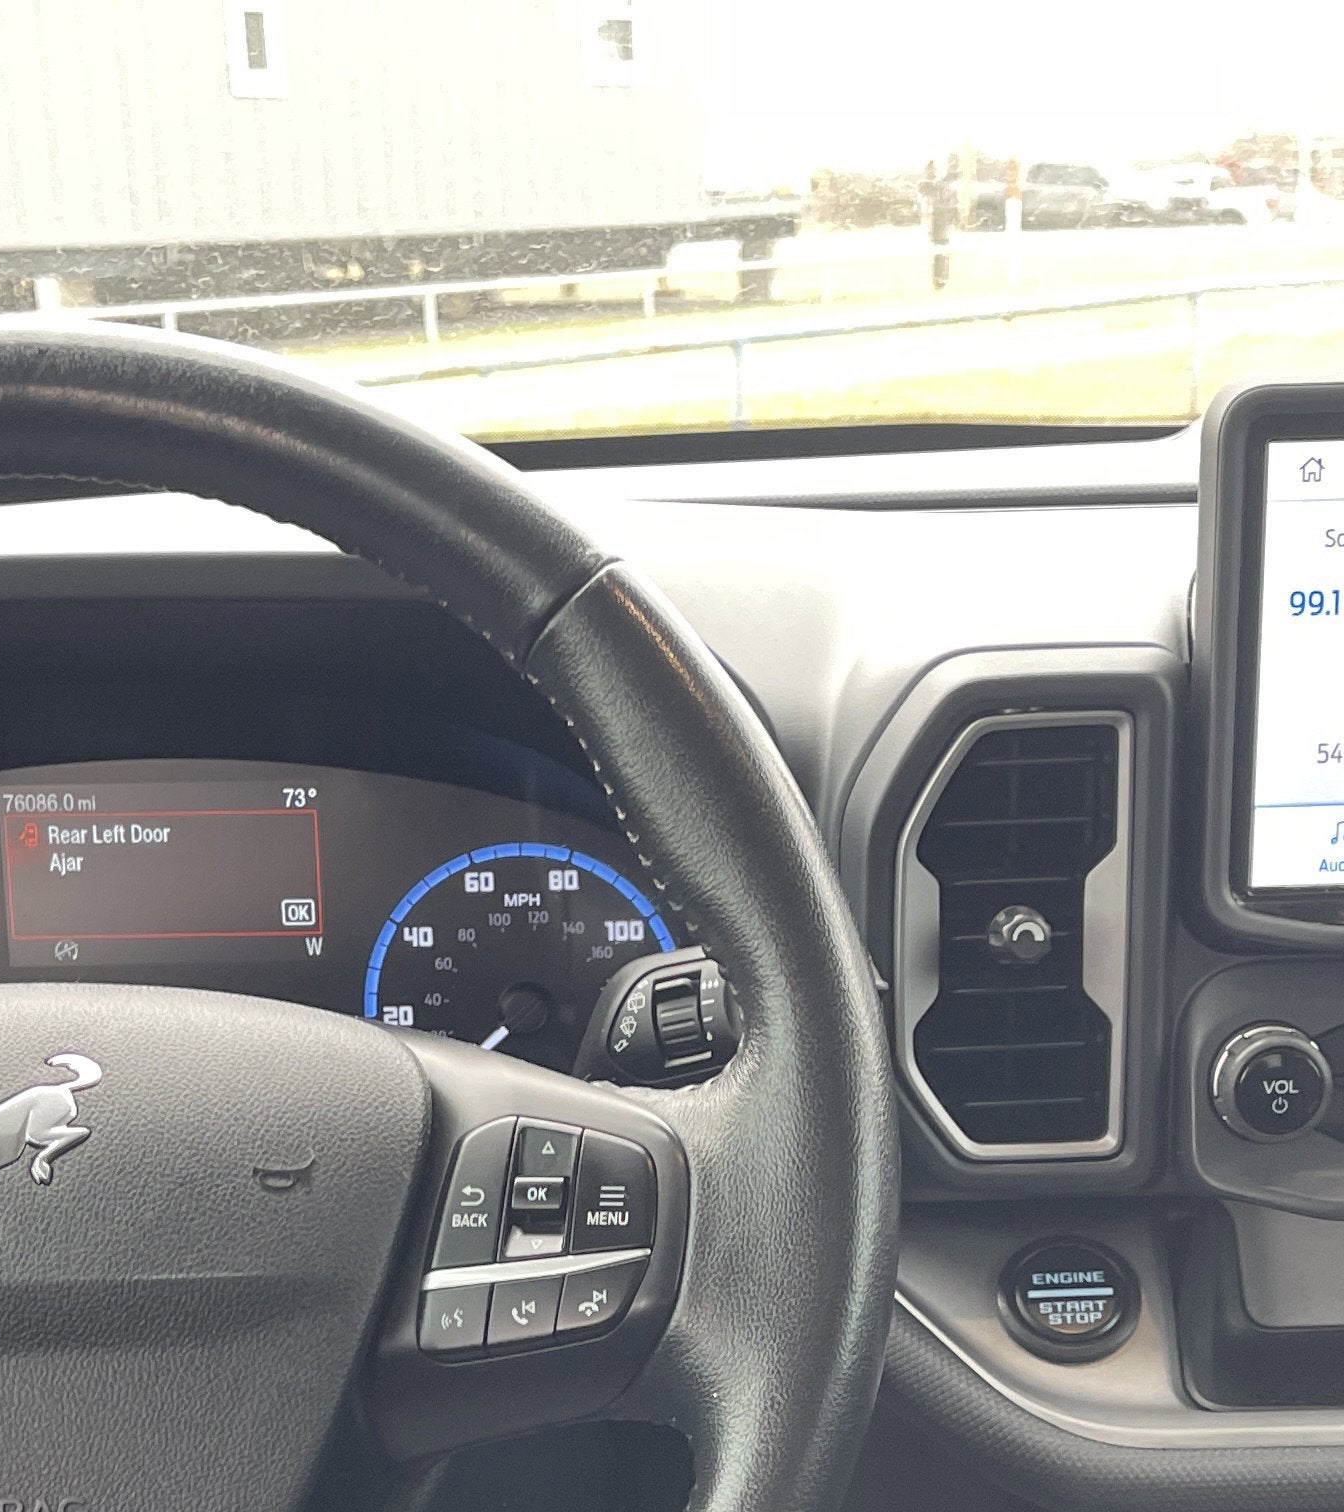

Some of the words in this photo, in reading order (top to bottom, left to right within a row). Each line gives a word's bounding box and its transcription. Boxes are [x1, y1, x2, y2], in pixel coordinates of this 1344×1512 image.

[1288, 590, 1342, 618] 99.1
[2, 793, 74, 812] 76086.0
[78, 794, 97, 811] mi
[48, 825, 87, 845] Rear
[92, 825, 126, 844] Left
[131, 823, 170, 844] Door
[49, 852, 83, 876] Ajar
[464, 872, 495, 893] 60
[548, 869, 579, 891] 80
[503, 893, 541, 908] MPH
[287, 904, 309, 921] OK
[487, 913, 511, 928] 100
[527, 910, 549, 926] 120
[403, 926, 434, 948] 40
[604, 920, 644, 943] 100
[305, 936, 323, 956] W
[382, 1005, 415, 1027] 20
[1262, 1078, 1299, 1096] VOL
[527, 1187, 548, 1202] OK
[451, 1212, 489, 1229] BACK
[586, 1211, 630, 1227] MENU
[1031, 1270, 1106, 1286] ENGINE
[1038, 1299, 1108, 1315] START
[1048, 1311, 1104, 1326] STOP
